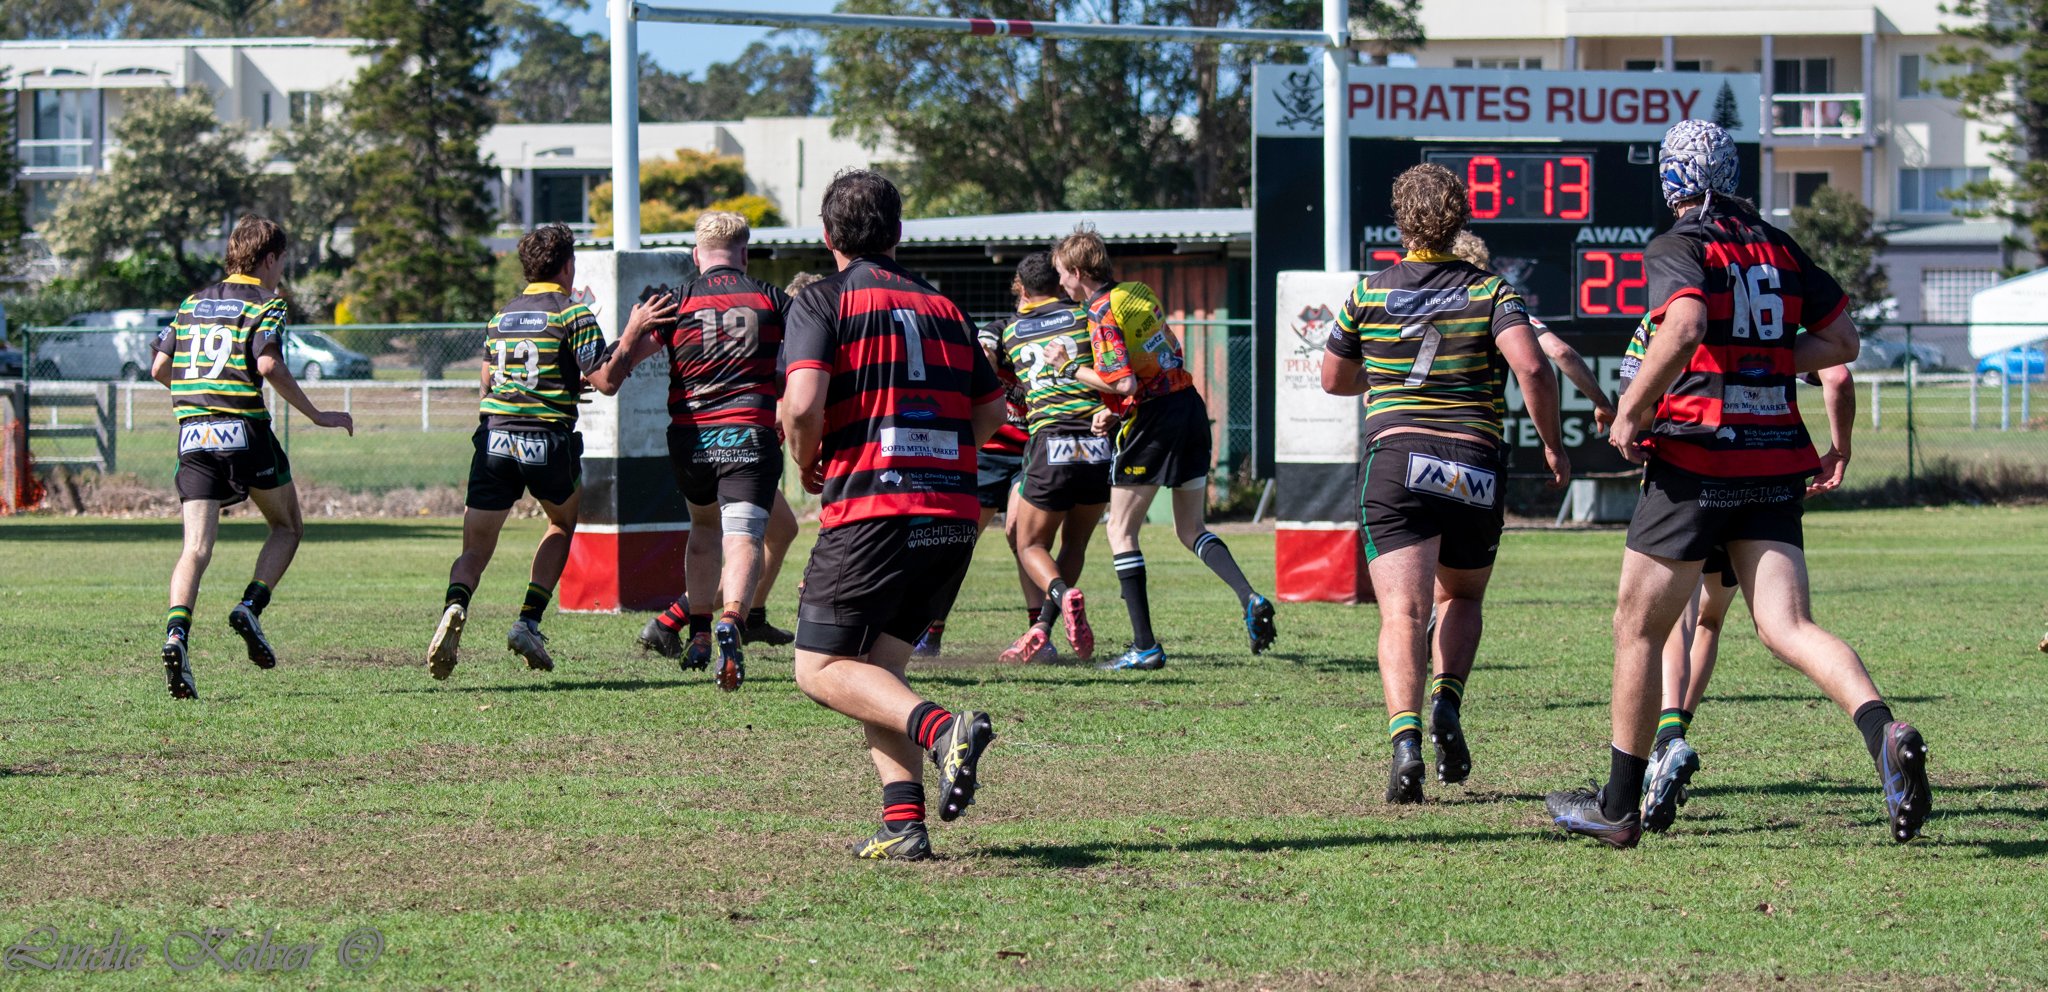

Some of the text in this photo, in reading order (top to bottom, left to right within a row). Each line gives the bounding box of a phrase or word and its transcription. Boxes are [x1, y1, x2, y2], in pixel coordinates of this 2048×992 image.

[1349, 82, 1700, 125] PIRATES RUGBY
[1364, 226, 1400, 243] HO
[1576, 227, 1655, 242] AWAY
[707, 275, 737, 287] 1973
[1580, 251, 1647, 315] 22
[1729, 262, 1785, 341] 16
[694, 306, 760, 358] 19
[891, 308, 927, 381] 1
[1145, 333, 1163, 351] Hertz
[184, 324, 233, 380] 19
[1400, 322, 1443, 387] 7
[494, 339, 540, 391] 13
[1284, 359, 1322, 376] PIRA
[1760, 403, 1786, 411] MARKE
[906, 445, 931, 453] METAL
[1699, 486, 1791, 500] ARCHITECTURA
[908, 525, 977, 540] ARCHITECTU
